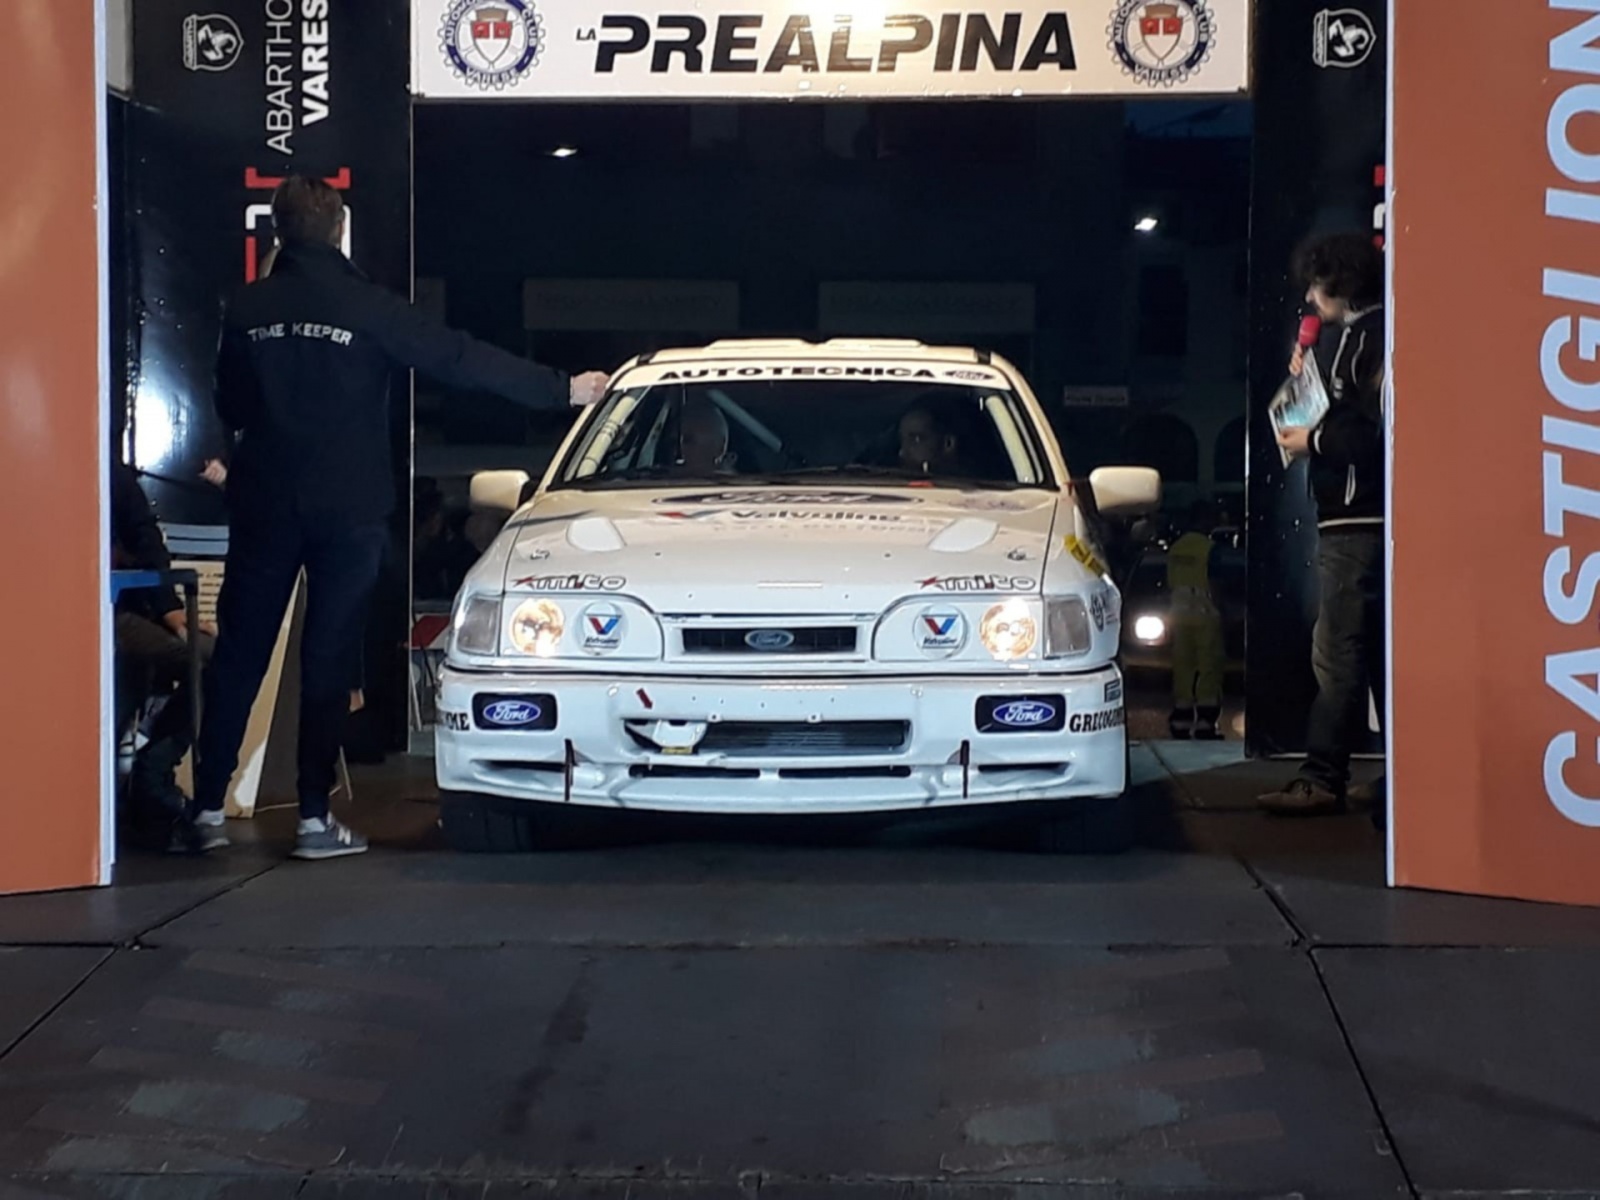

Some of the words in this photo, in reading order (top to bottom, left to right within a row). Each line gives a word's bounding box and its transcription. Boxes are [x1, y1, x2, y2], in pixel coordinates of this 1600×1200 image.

[521, 9, 538, 46] CLUB
[1192, 4, 1209, 43] CLUB
[576, 27, 598, 41] LA
[594, 12, 1078, 73] PREALPINA
[247, 323, 285, 342] TIME
[292, 322, 353, 346] KEEPER
[658, 366, 936, 381] AUTOTECNICA
[731, 510, 900, 522] Valvoline
[491, 702, 532, 721] Ford
[1003, 703, 1046, 722] Ford
